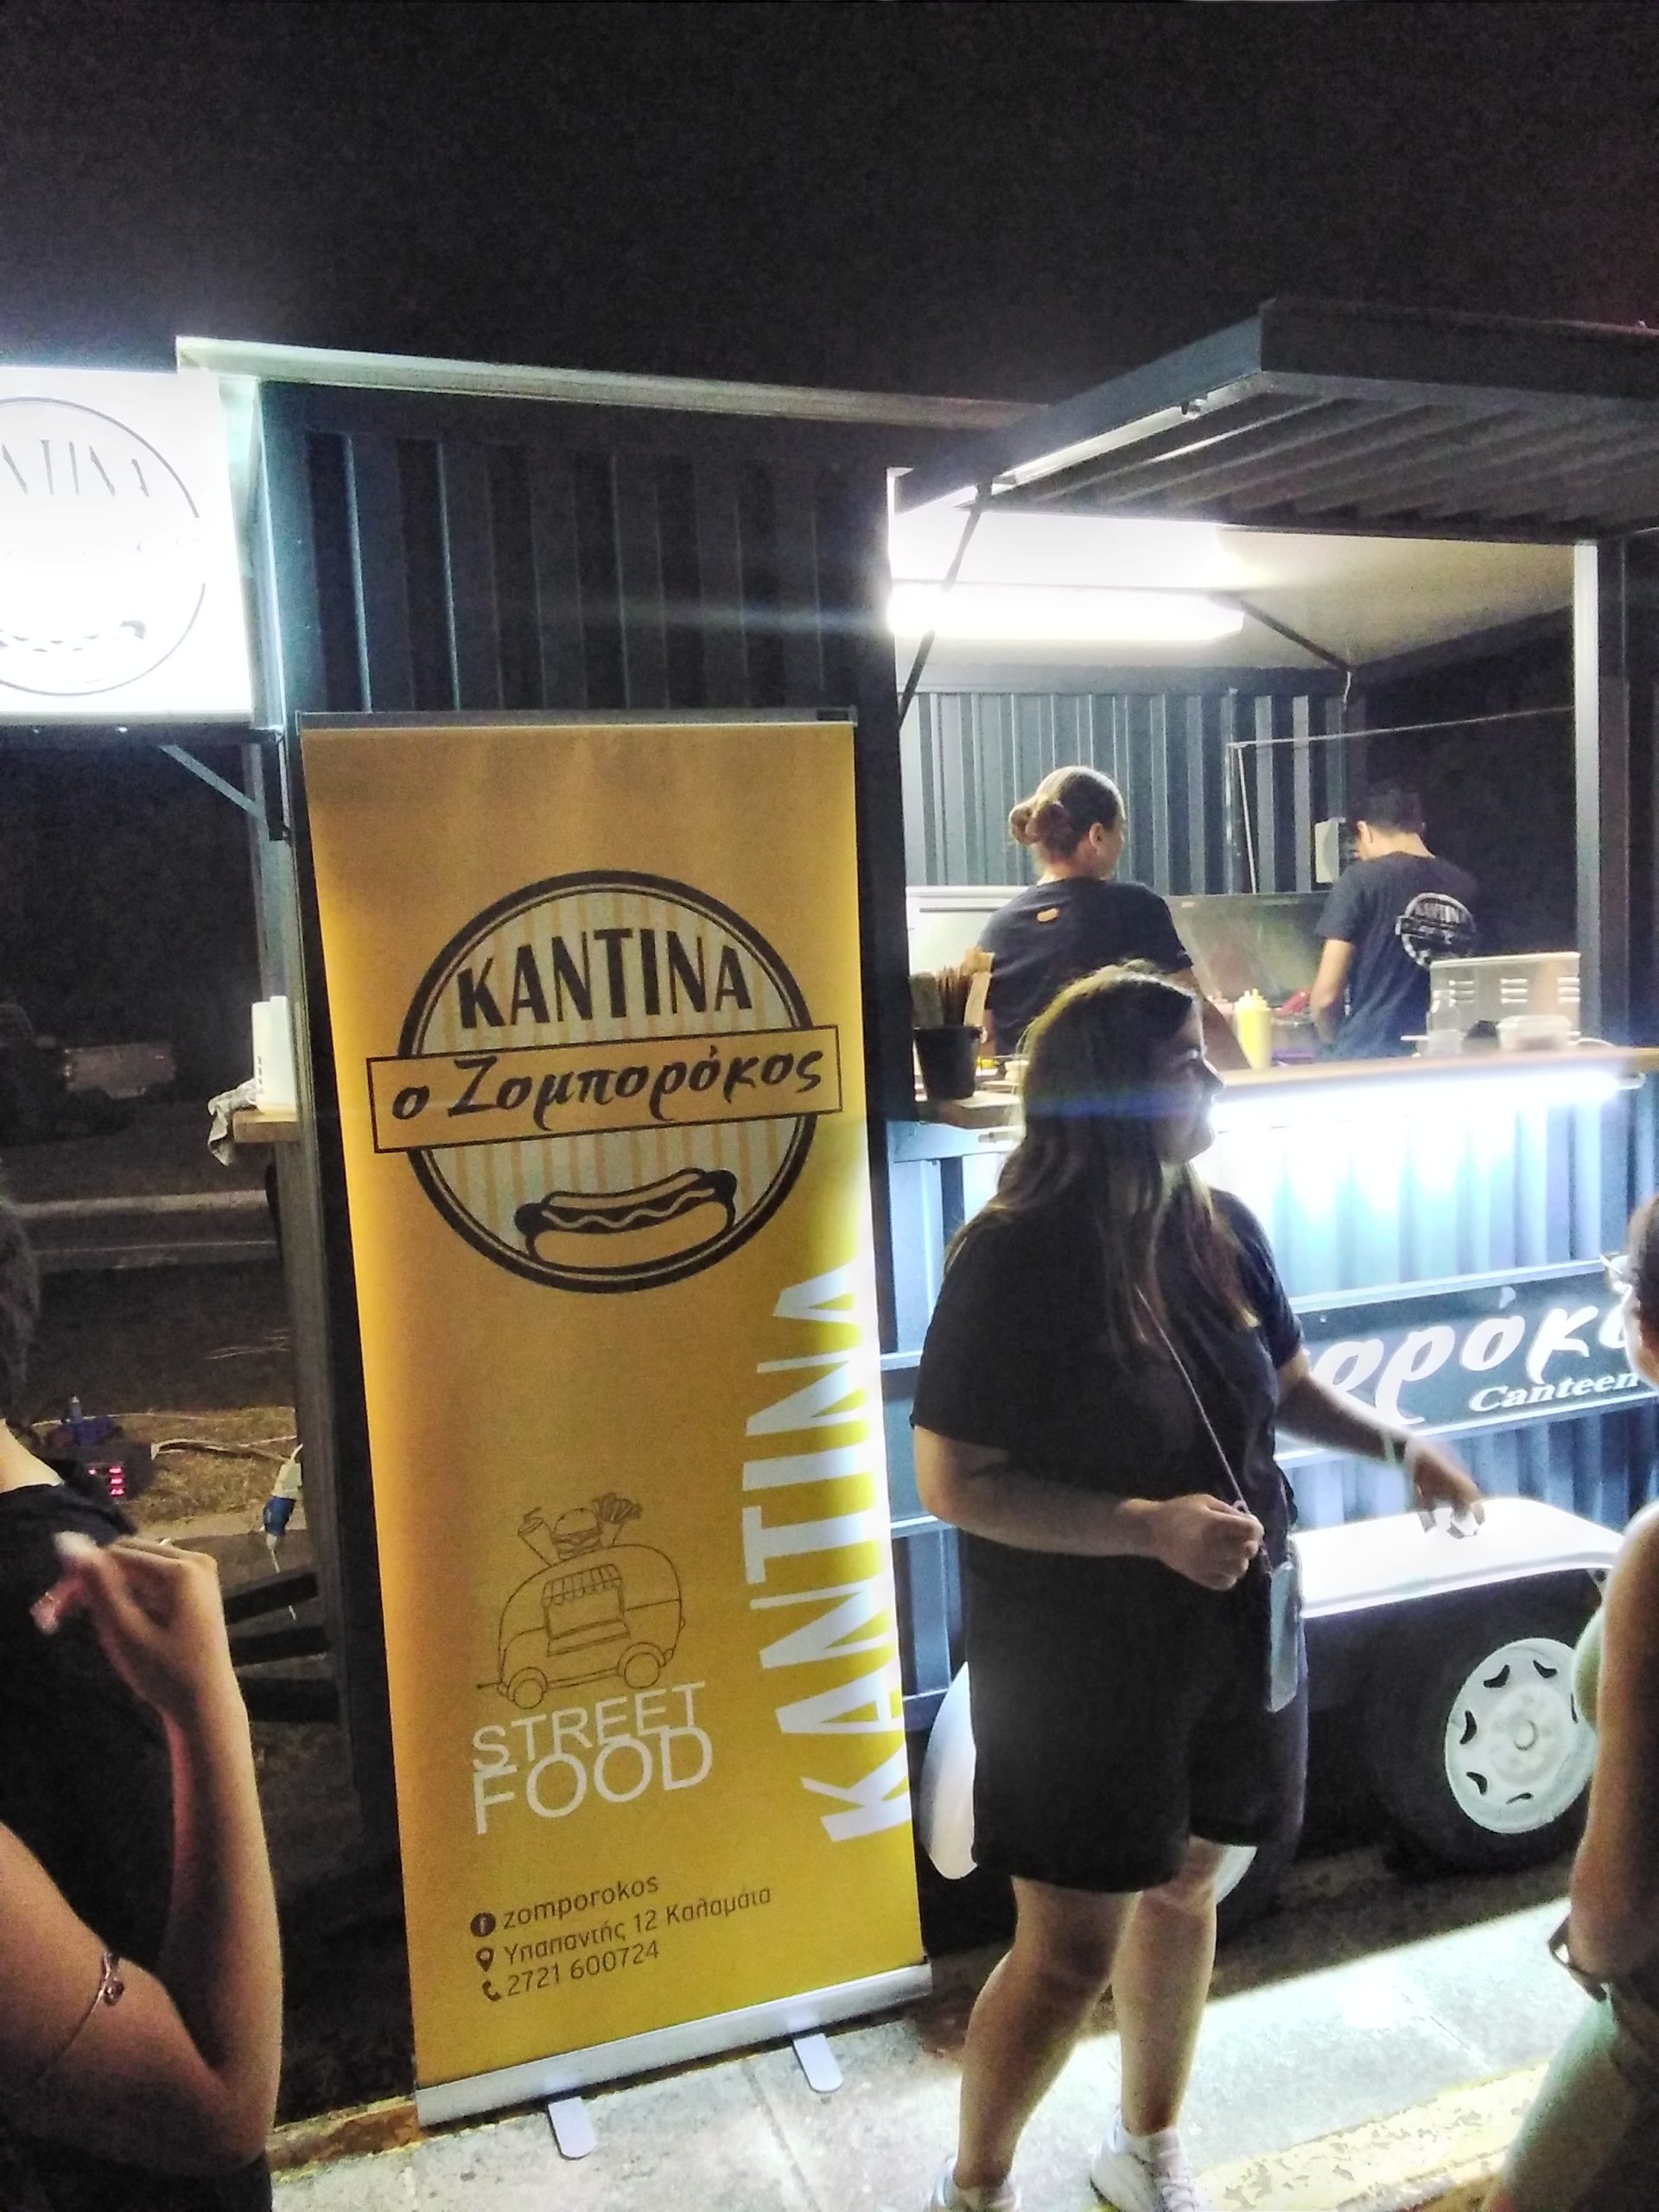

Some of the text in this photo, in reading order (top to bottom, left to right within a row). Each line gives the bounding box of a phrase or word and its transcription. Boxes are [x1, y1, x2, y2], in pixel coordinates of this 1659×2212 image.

[1469, 1371, 1639, 1412] Canteen
[472, 1680, 706, 1770] STREET
[473, 1726, 714, 1834] FOOD
[504, 1875, 659, 1929] zomporokos
[634, 1908, 658, 1933] 12
[506, 1939, 659, 1997] 2721 600724
